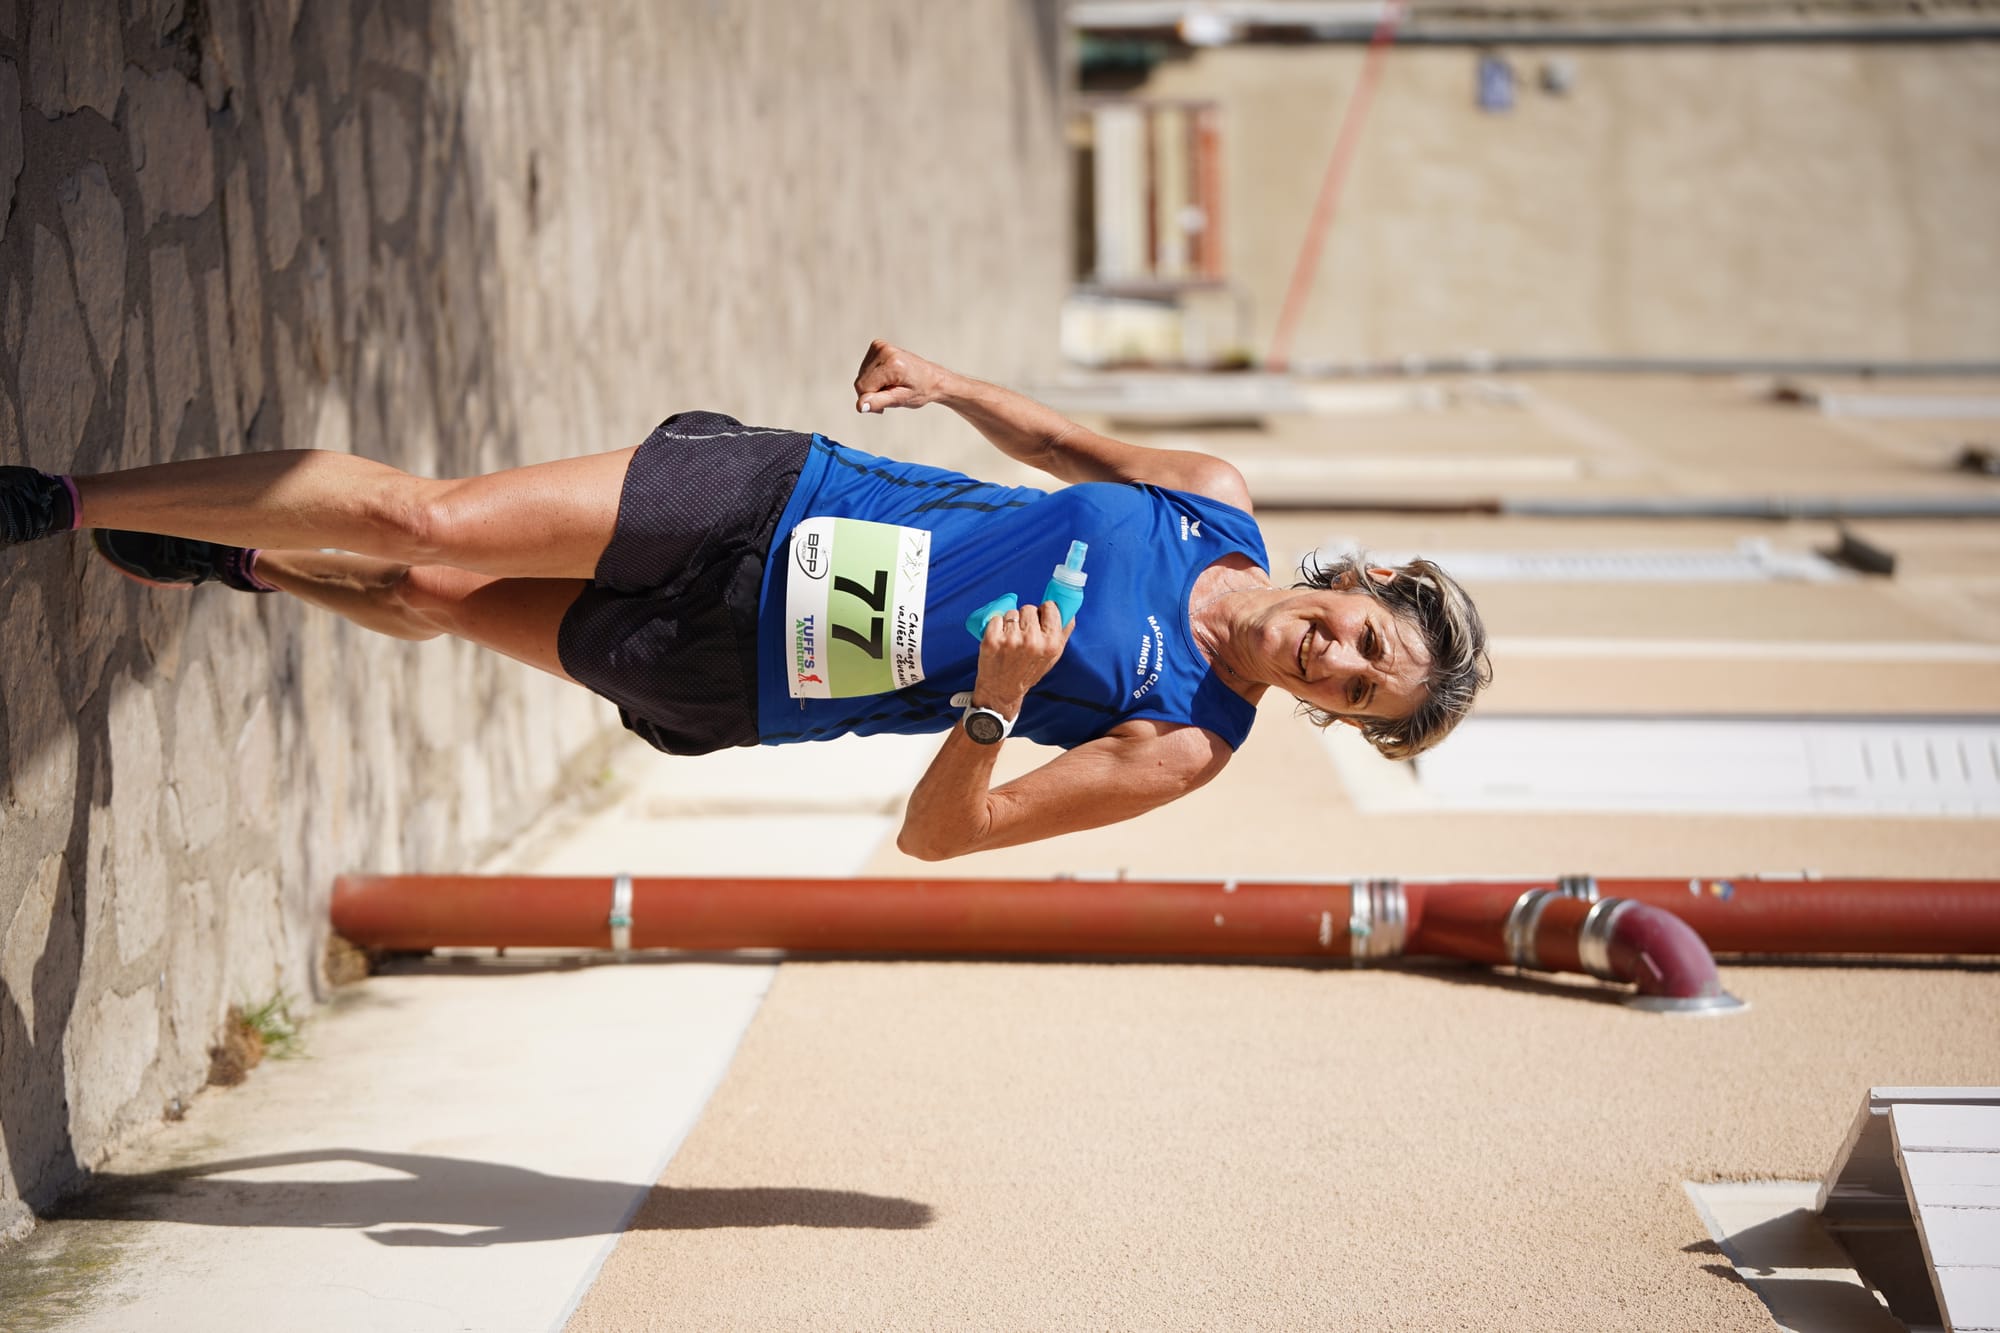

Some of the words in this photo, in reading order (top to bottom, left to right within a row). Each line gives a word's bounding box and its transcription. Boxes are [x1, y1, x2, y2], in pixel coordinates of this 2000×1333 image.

[806, 533, 819, 572] BFP
[803, 614, 815, 669] TUFF'S
[831, 570, 888, 660] 77
[896, 605, 907, 648] vallées
[904, 612, 919, 670] Challenge
[796, 618, 806, 673] Aventure
[1147, 615, 1163, 672] MACADAM
[1133, 673, 1159, 699] CLUB
